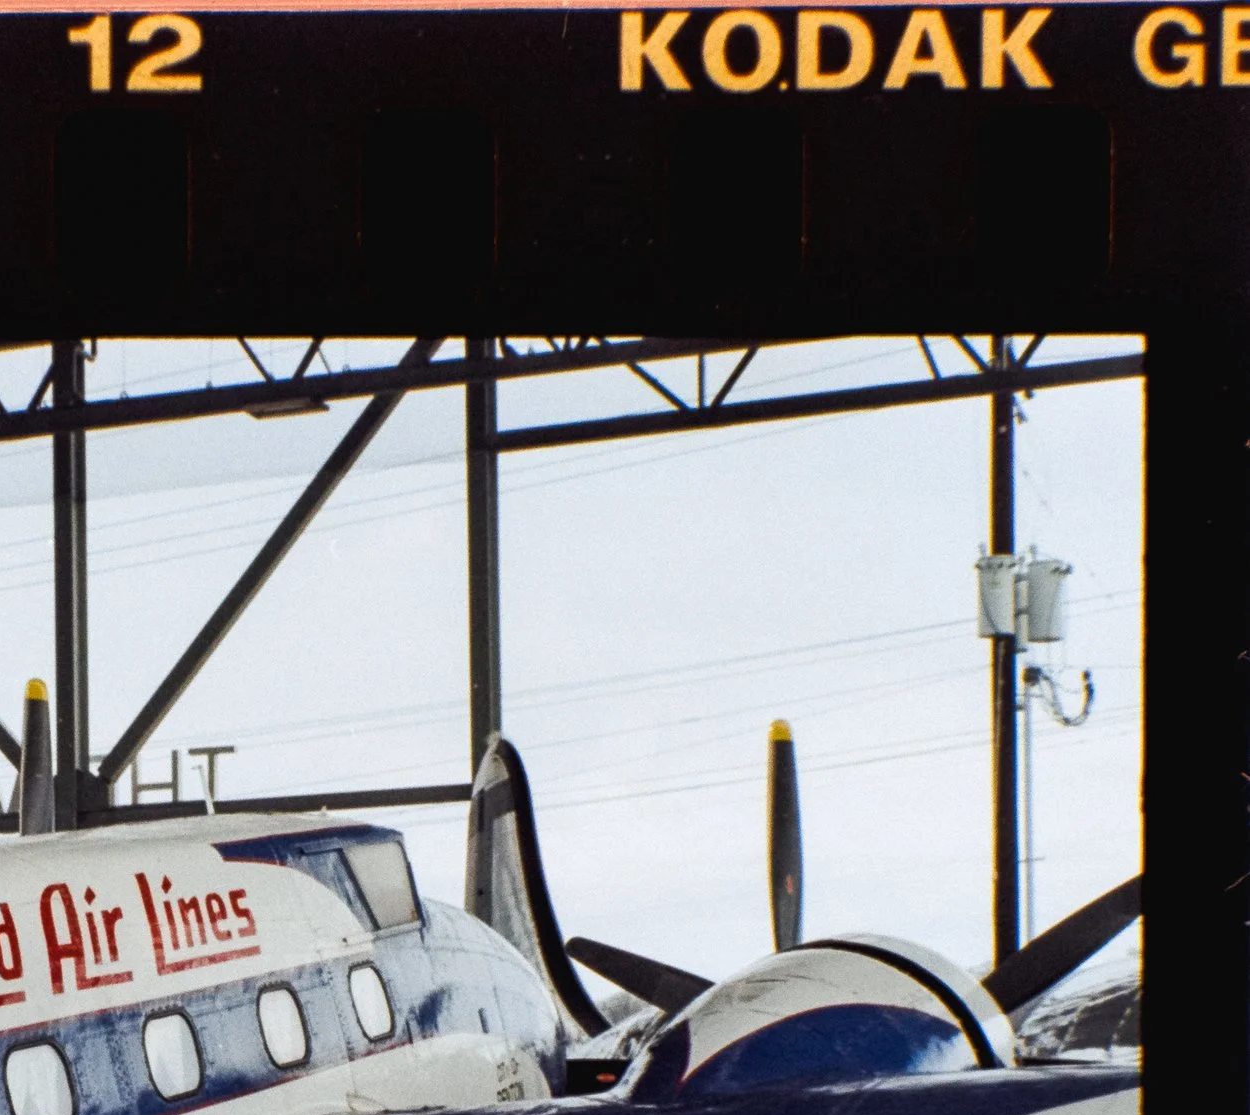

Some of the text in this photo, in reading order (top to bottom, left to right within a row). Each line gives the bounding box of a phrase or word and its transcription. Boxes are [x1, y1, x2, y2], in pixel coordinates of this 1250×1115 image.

[68, 14, 203, 93] 12
[620, 9, 1054, 94] KODAK
[39, 882, 134, 995] Air
[134, 872, 262, 976] Lines
